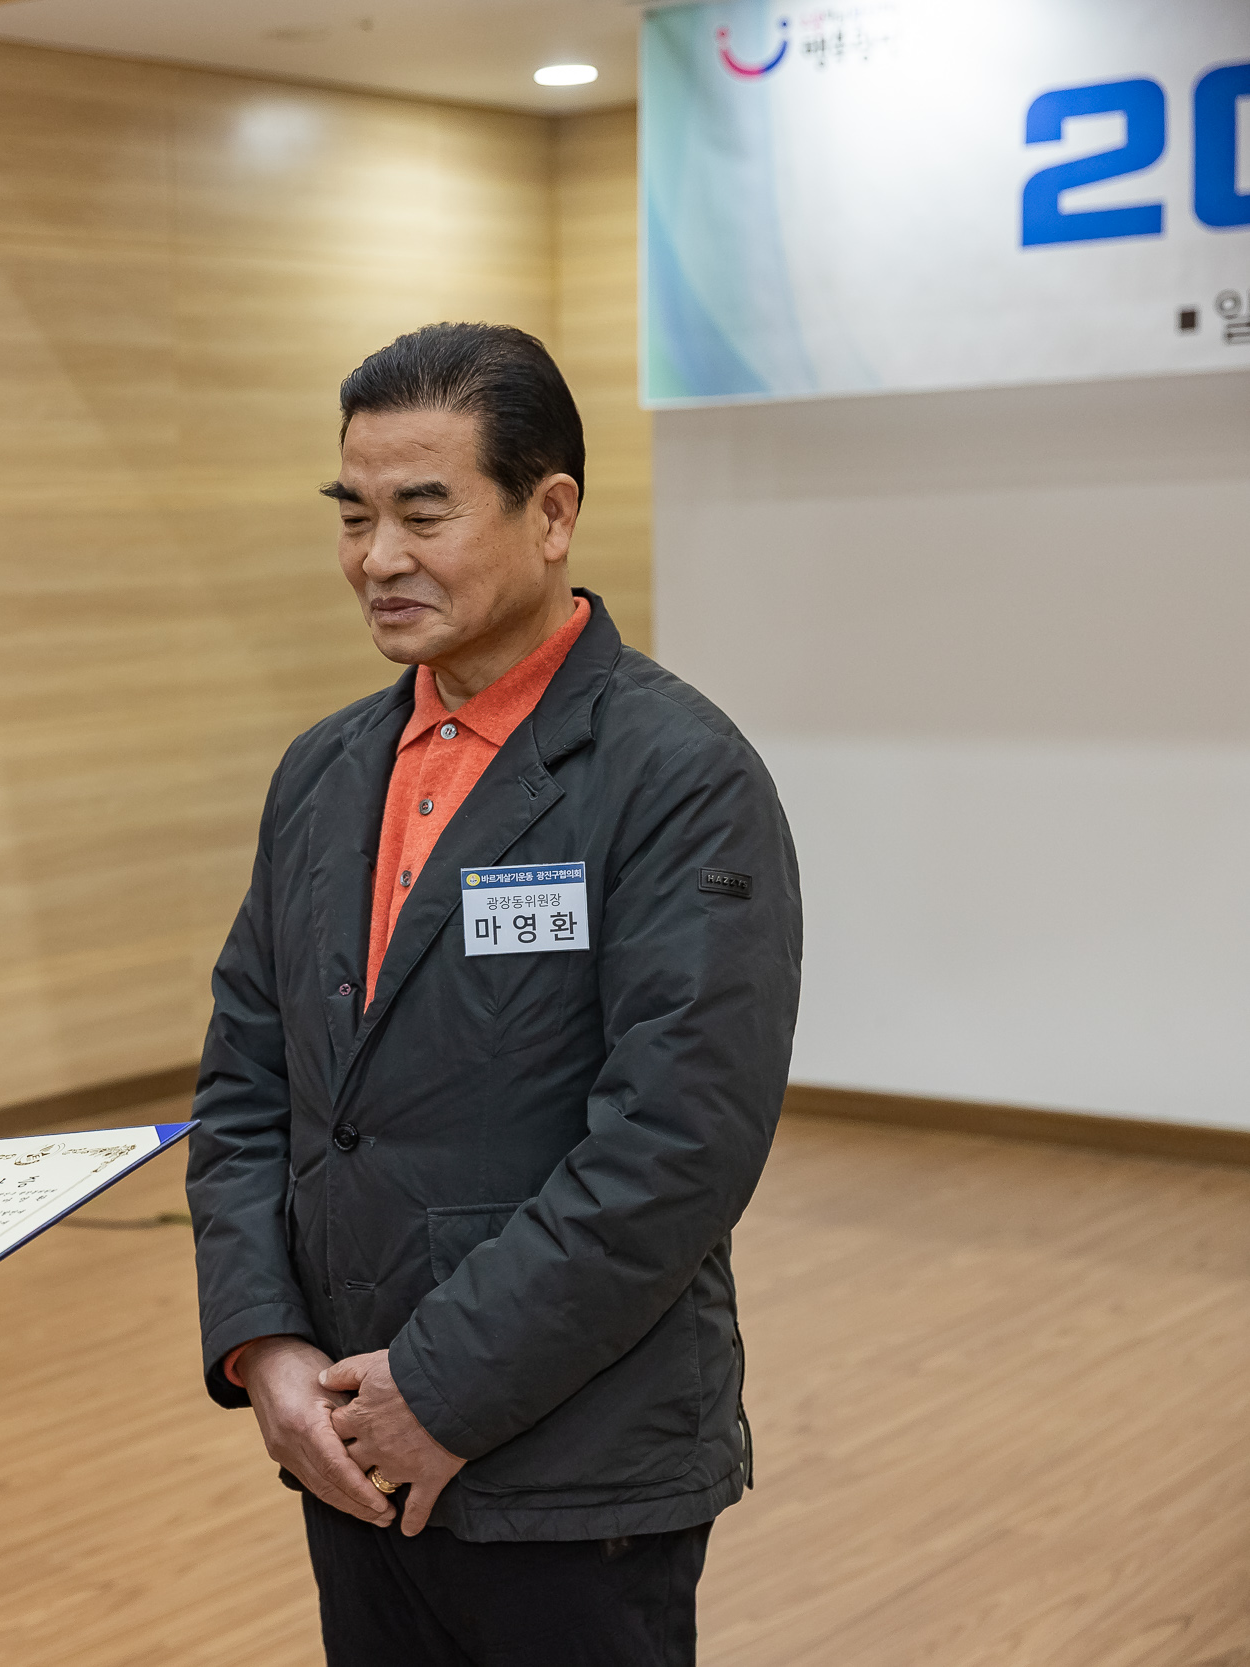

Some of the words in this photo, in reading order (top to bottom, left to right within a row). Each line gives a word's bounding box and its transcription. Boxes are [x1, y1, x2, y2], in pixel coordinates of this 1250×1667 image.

[481, 871, 534, 884] 바르게살기운동
[536, 869, 582, 881] 광진구협의회
[706, 874, 748, 889] HAZZYS
[486, 893, 562, 910] 광장동위원장
